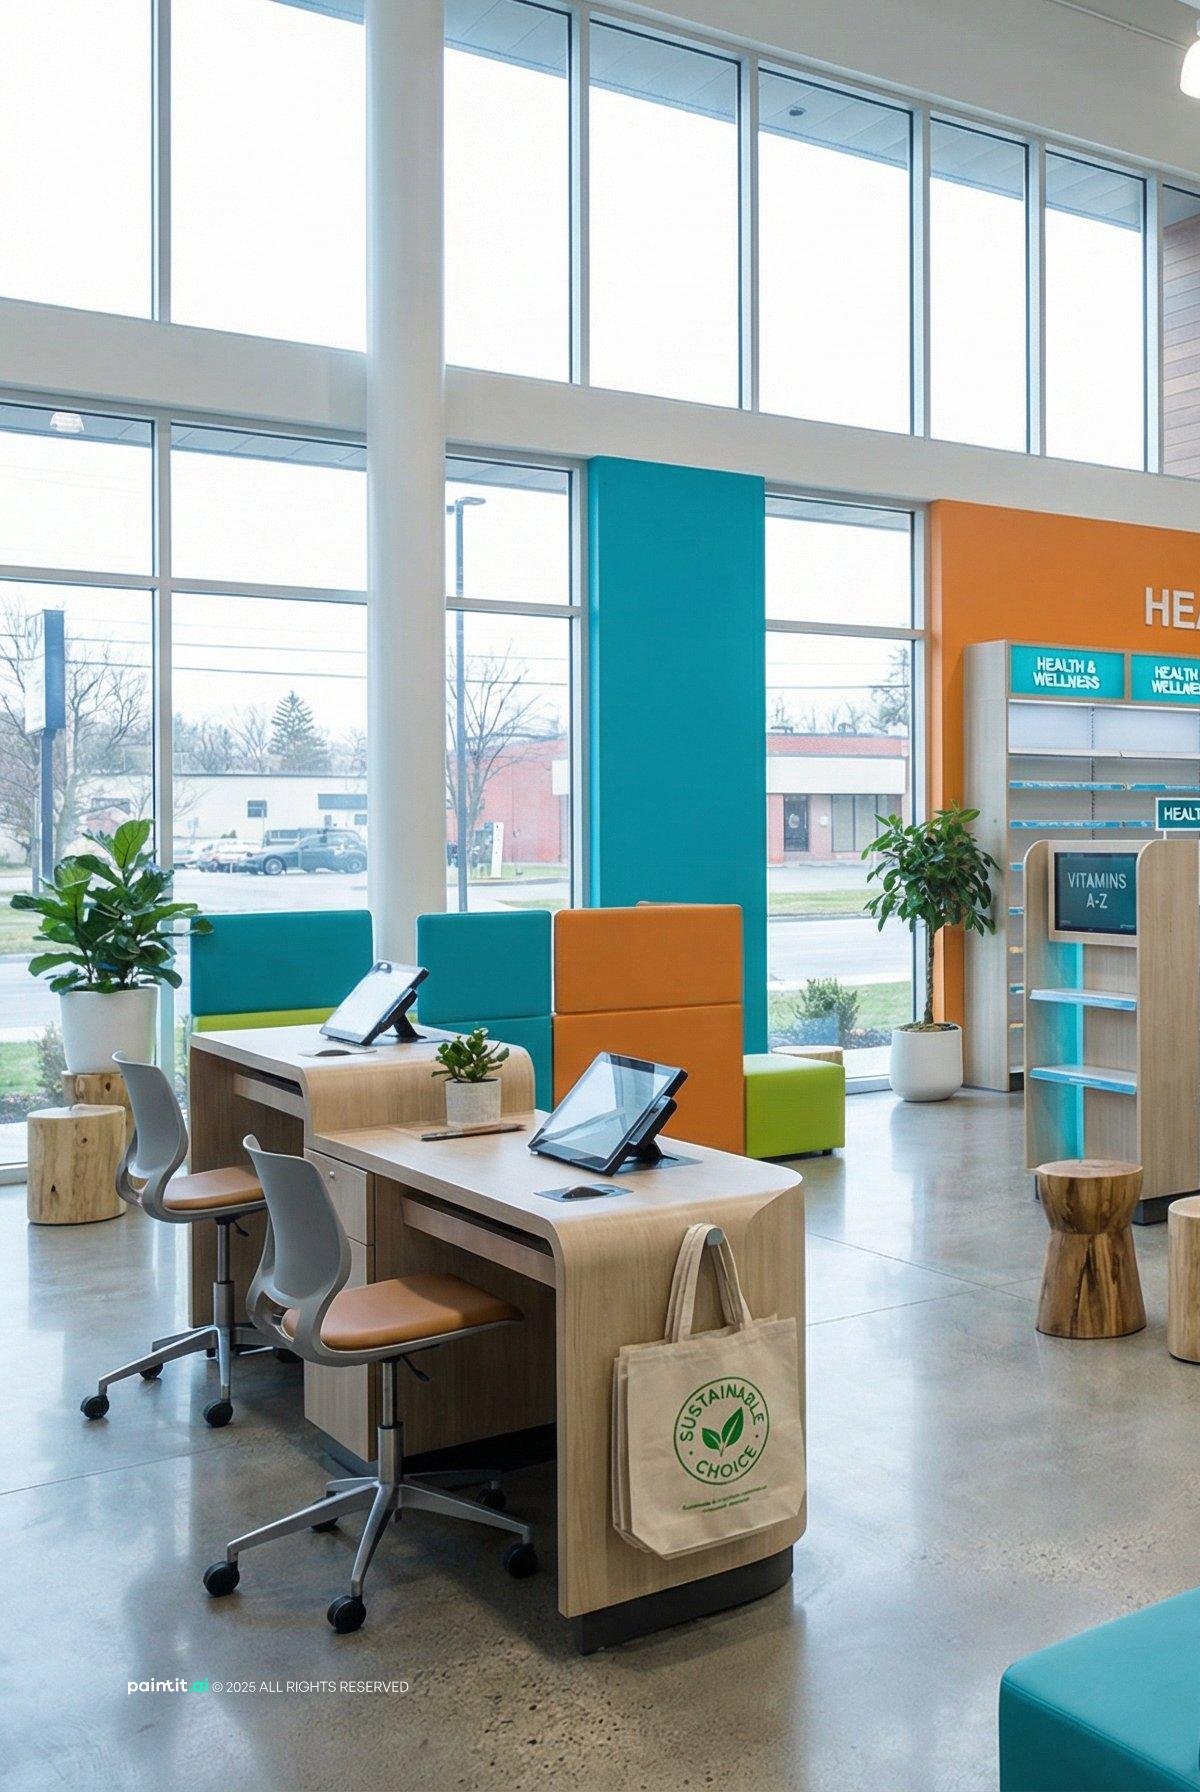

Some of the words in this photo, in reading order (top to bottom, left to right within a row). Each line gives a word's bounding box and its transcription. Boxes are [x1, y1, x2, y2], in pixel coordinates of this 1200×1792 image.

[1037, 656, 1085, 674] HEALTH
[1087, 660, 1096, 674] &
[1155, 665, 1197, 681] HEALTH
[1033, 671, 1100, 690] WELLNESS
[1067, 871, 1127, 890] VITAMINS
[1086, 892, 1108, 909] A-Z
[679, 1383, 765, 1442] SUSTAINABLE
[695, 1445, 757, 1479] CHOICE
